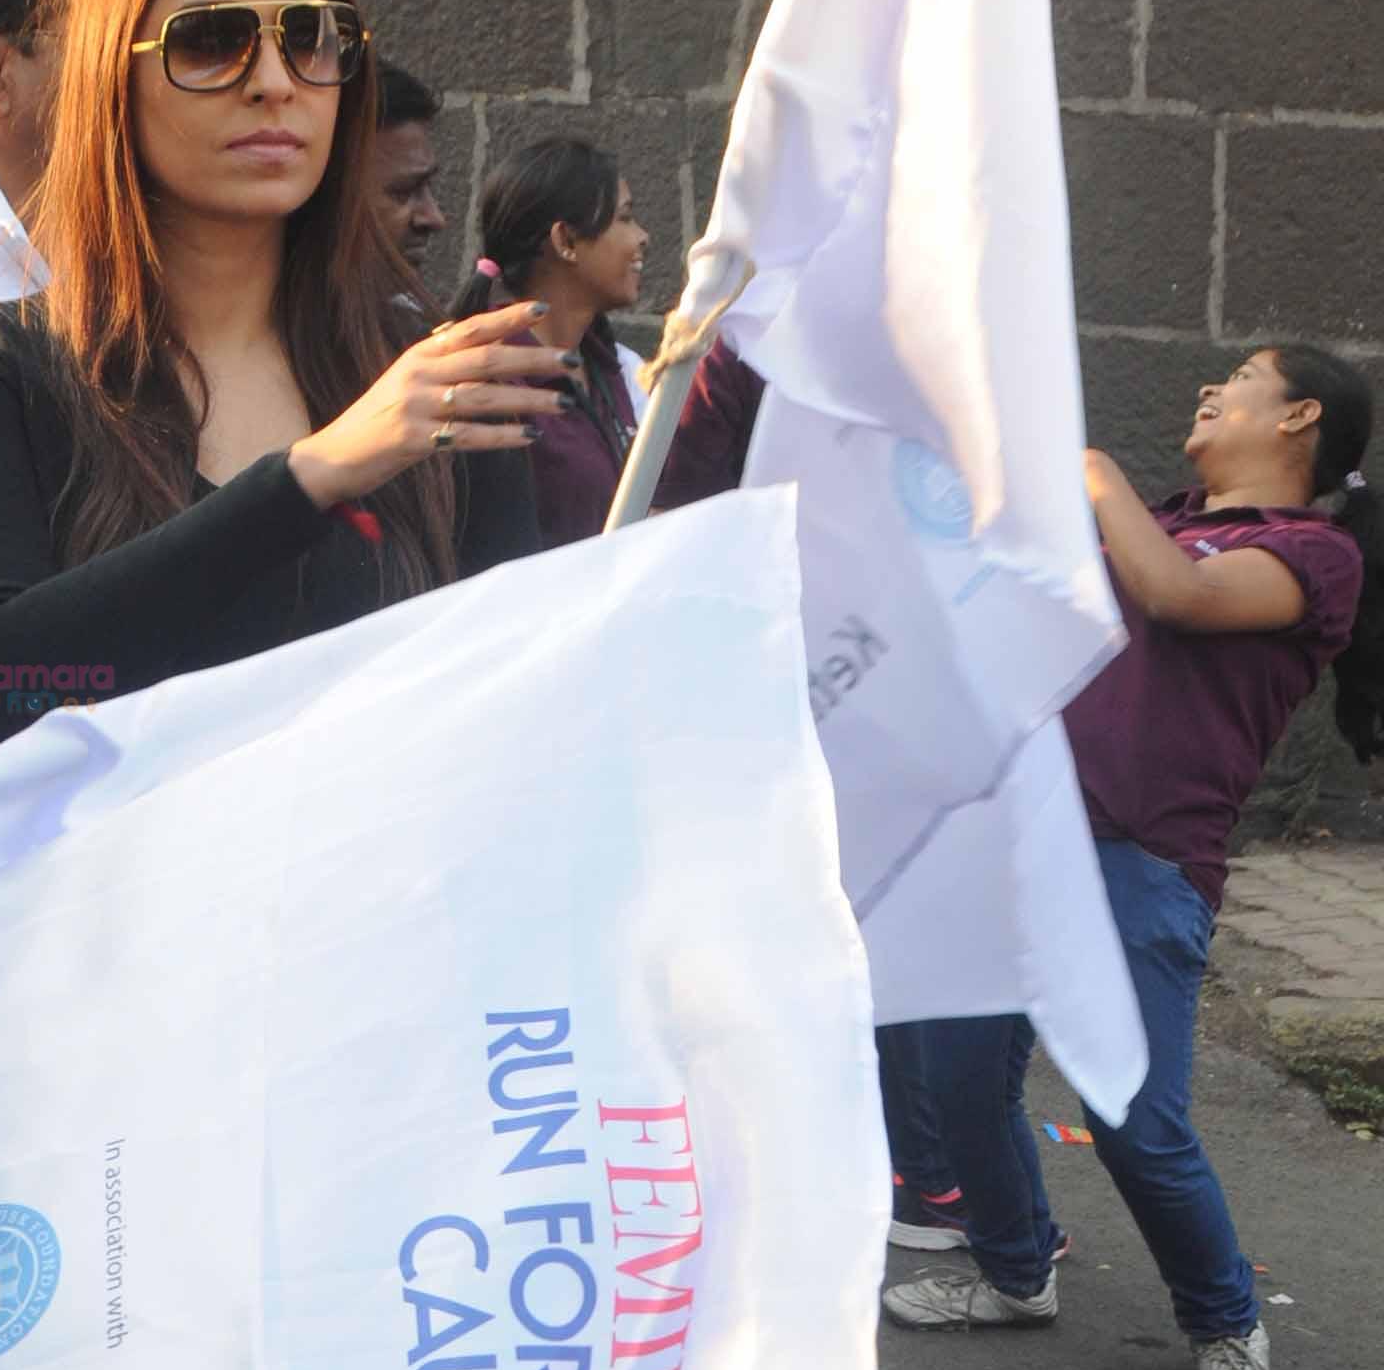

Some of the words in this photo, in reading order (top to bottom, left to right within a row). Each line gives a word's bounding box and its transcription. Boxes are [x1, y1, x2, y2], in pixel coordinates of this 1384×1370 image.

[485, 1007, 588, 1175] RUN
[105, 1138, 127, 1161] In
[105, 1167, 127, 1291] association
[106, 1295, 128, 1350] with
